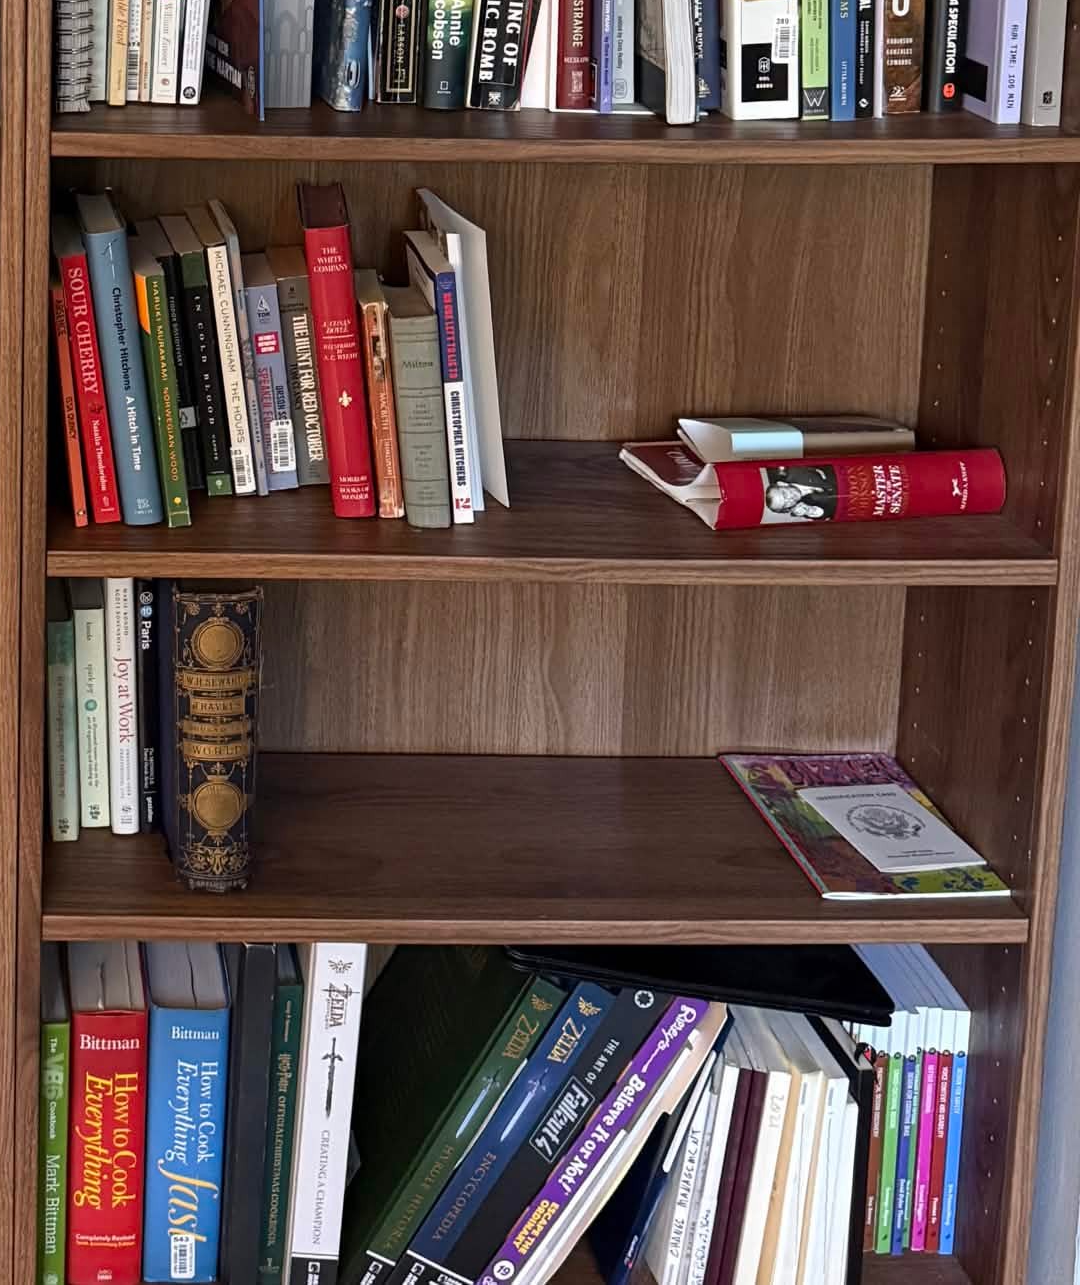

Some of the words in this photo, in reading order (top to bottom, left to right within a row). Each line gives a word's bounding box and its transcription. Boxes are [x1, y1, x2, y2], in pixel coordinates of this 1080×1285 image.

[68, 267, 87, 317] SOUR
[76, 320, 98, 394] CHERRY
[873, 465, 886, 516] MASTER
[890, 465, 902, 514] SENATE
[141, 621, 152, 649] Paris
[114, 657, 131, 681] Joy
[118, 685, 130, 699] at
[119, 702, 135, 743] Work
[80, 1034, 140, 1051] Bittman
[172, 1026, 219, 1040] Bittman
[114, 1073, 138, 1123] How
[165, 1060, 198, 1166] Everything
[602, 1074, 646, 1126] Believe
[73, 1071, 113, 1210] Everything
[113, 1128, 129, 1148] to
[580, 1141, 596, 1157] or
[592, 1128, 610, 1144] It
[111, 1152, 136, 1208] Cook
[558, 1160, 588, 1195] Not!
